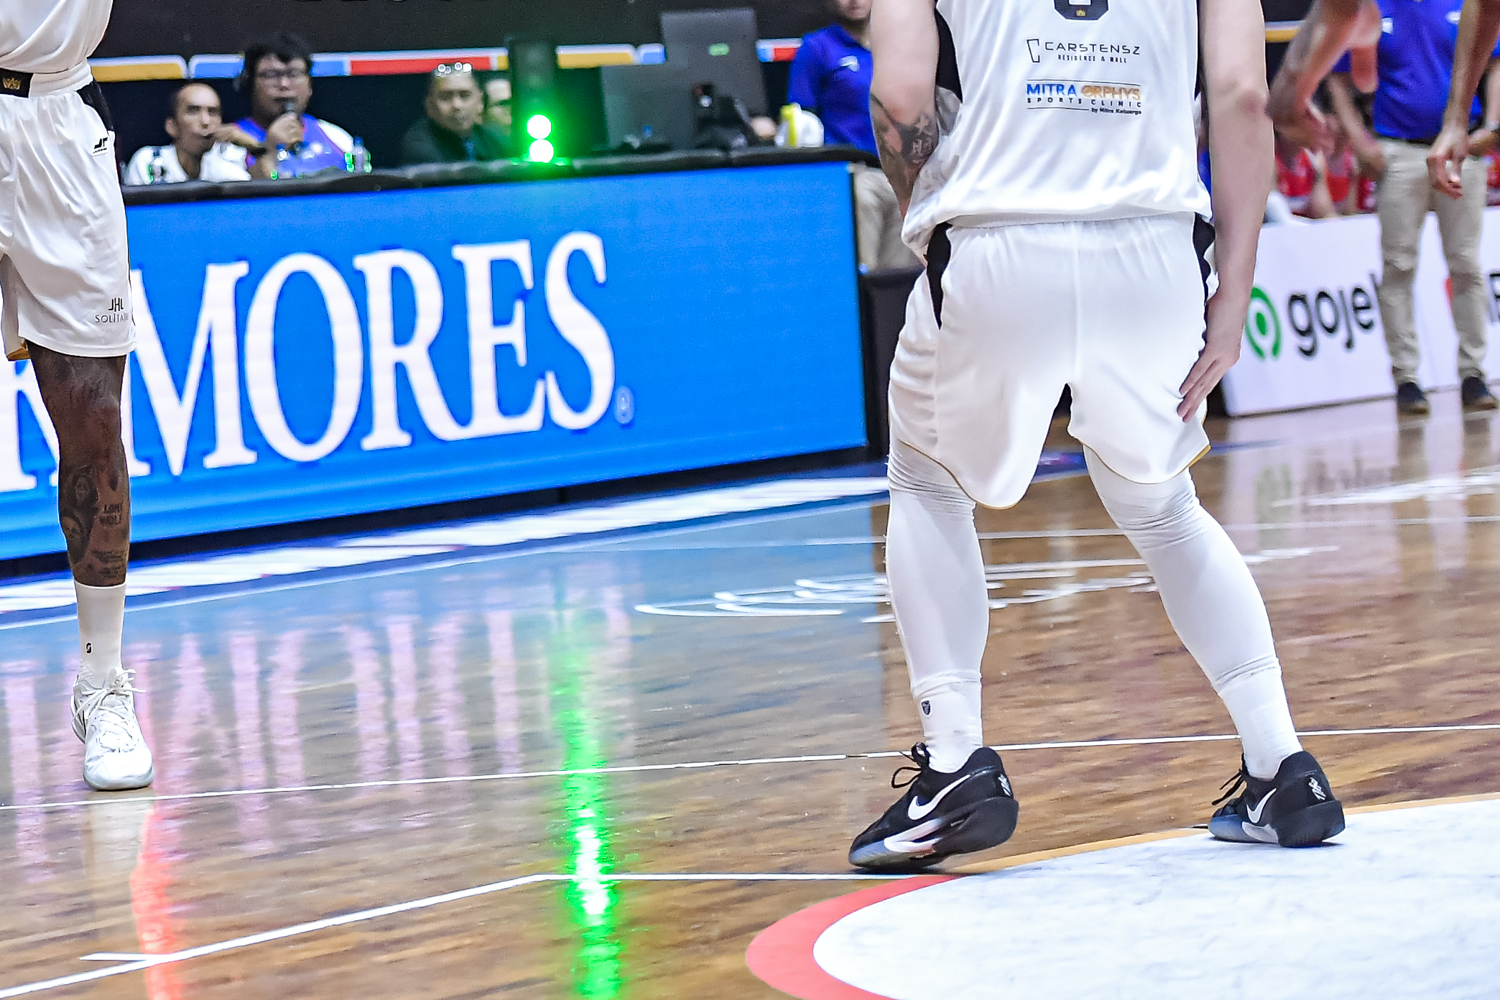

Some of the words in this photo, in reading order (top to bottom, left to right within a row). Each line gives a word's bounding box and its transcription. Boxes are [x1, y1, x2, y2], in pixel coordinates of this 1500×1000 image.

[1044, 41, 1141, 56] CARSTENSZ
[1026, 83, 1077, 97] MITRA
[1026, 96, 1083, 105] SPORTS
[1090, 98, 1143, 109] CLINIC
